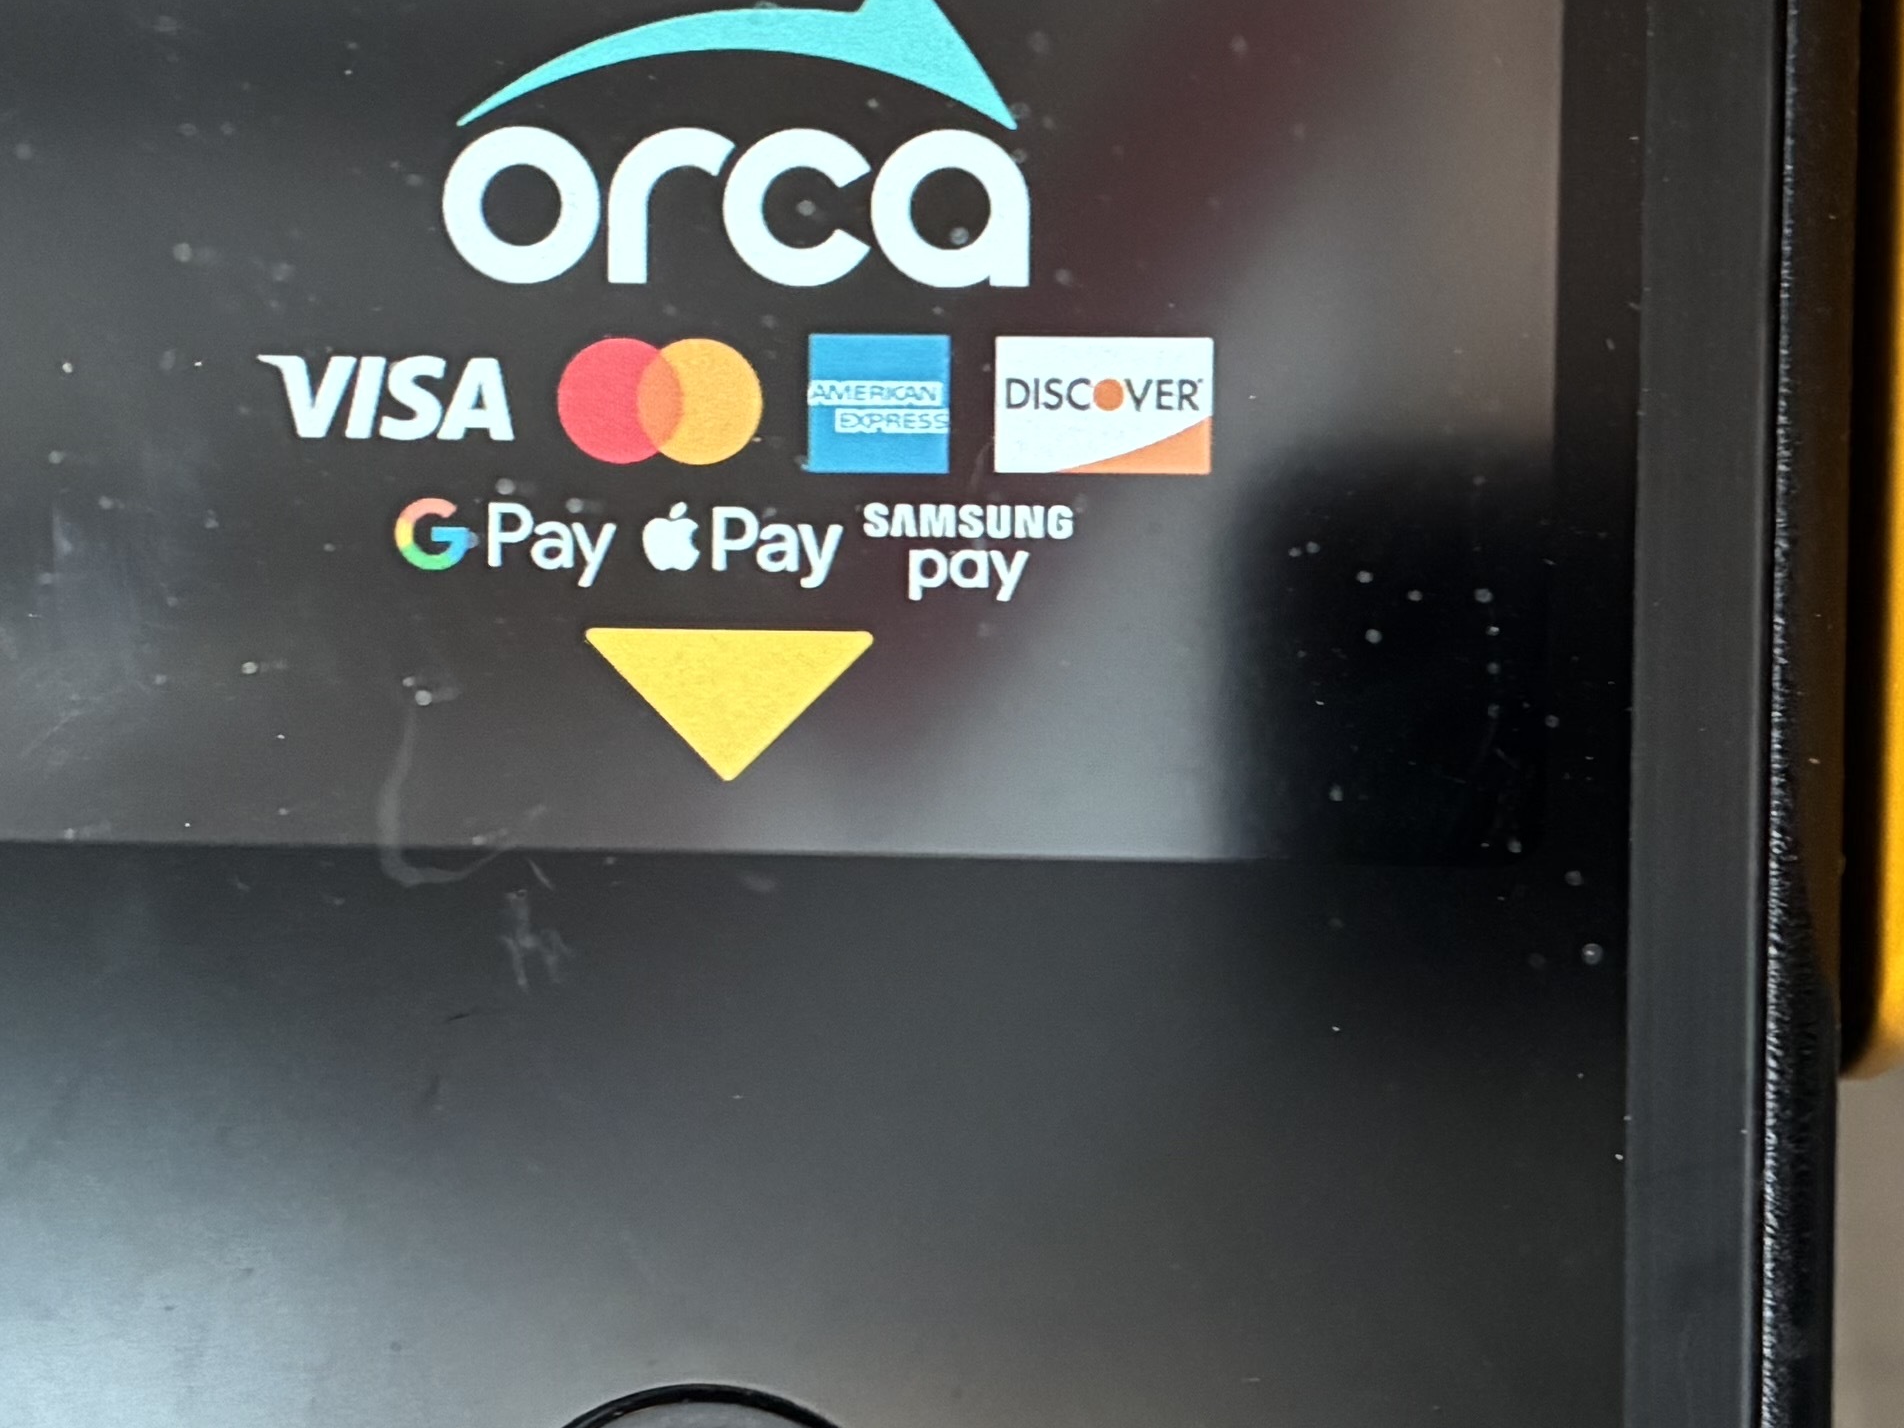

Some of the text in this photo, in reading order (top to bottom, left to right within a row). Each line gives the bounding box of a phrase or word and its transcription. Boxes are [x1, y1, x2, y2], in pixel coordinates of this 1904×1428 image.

[442, 124, 1031, 289] orca
[256, 353, 516, 442] VISA
[809, 383, 937, 403] AMERICAN
[839, 411, 949, 430] EXPRESS
[1005, 376, 1202, 412] DISCOVER
[486, 501, 617, 588] Pay
[710, 506, 844, 589] Pay
[862, 501, 1075, 540] SAMSUNG
[907, 547, 1031, 602] pay
